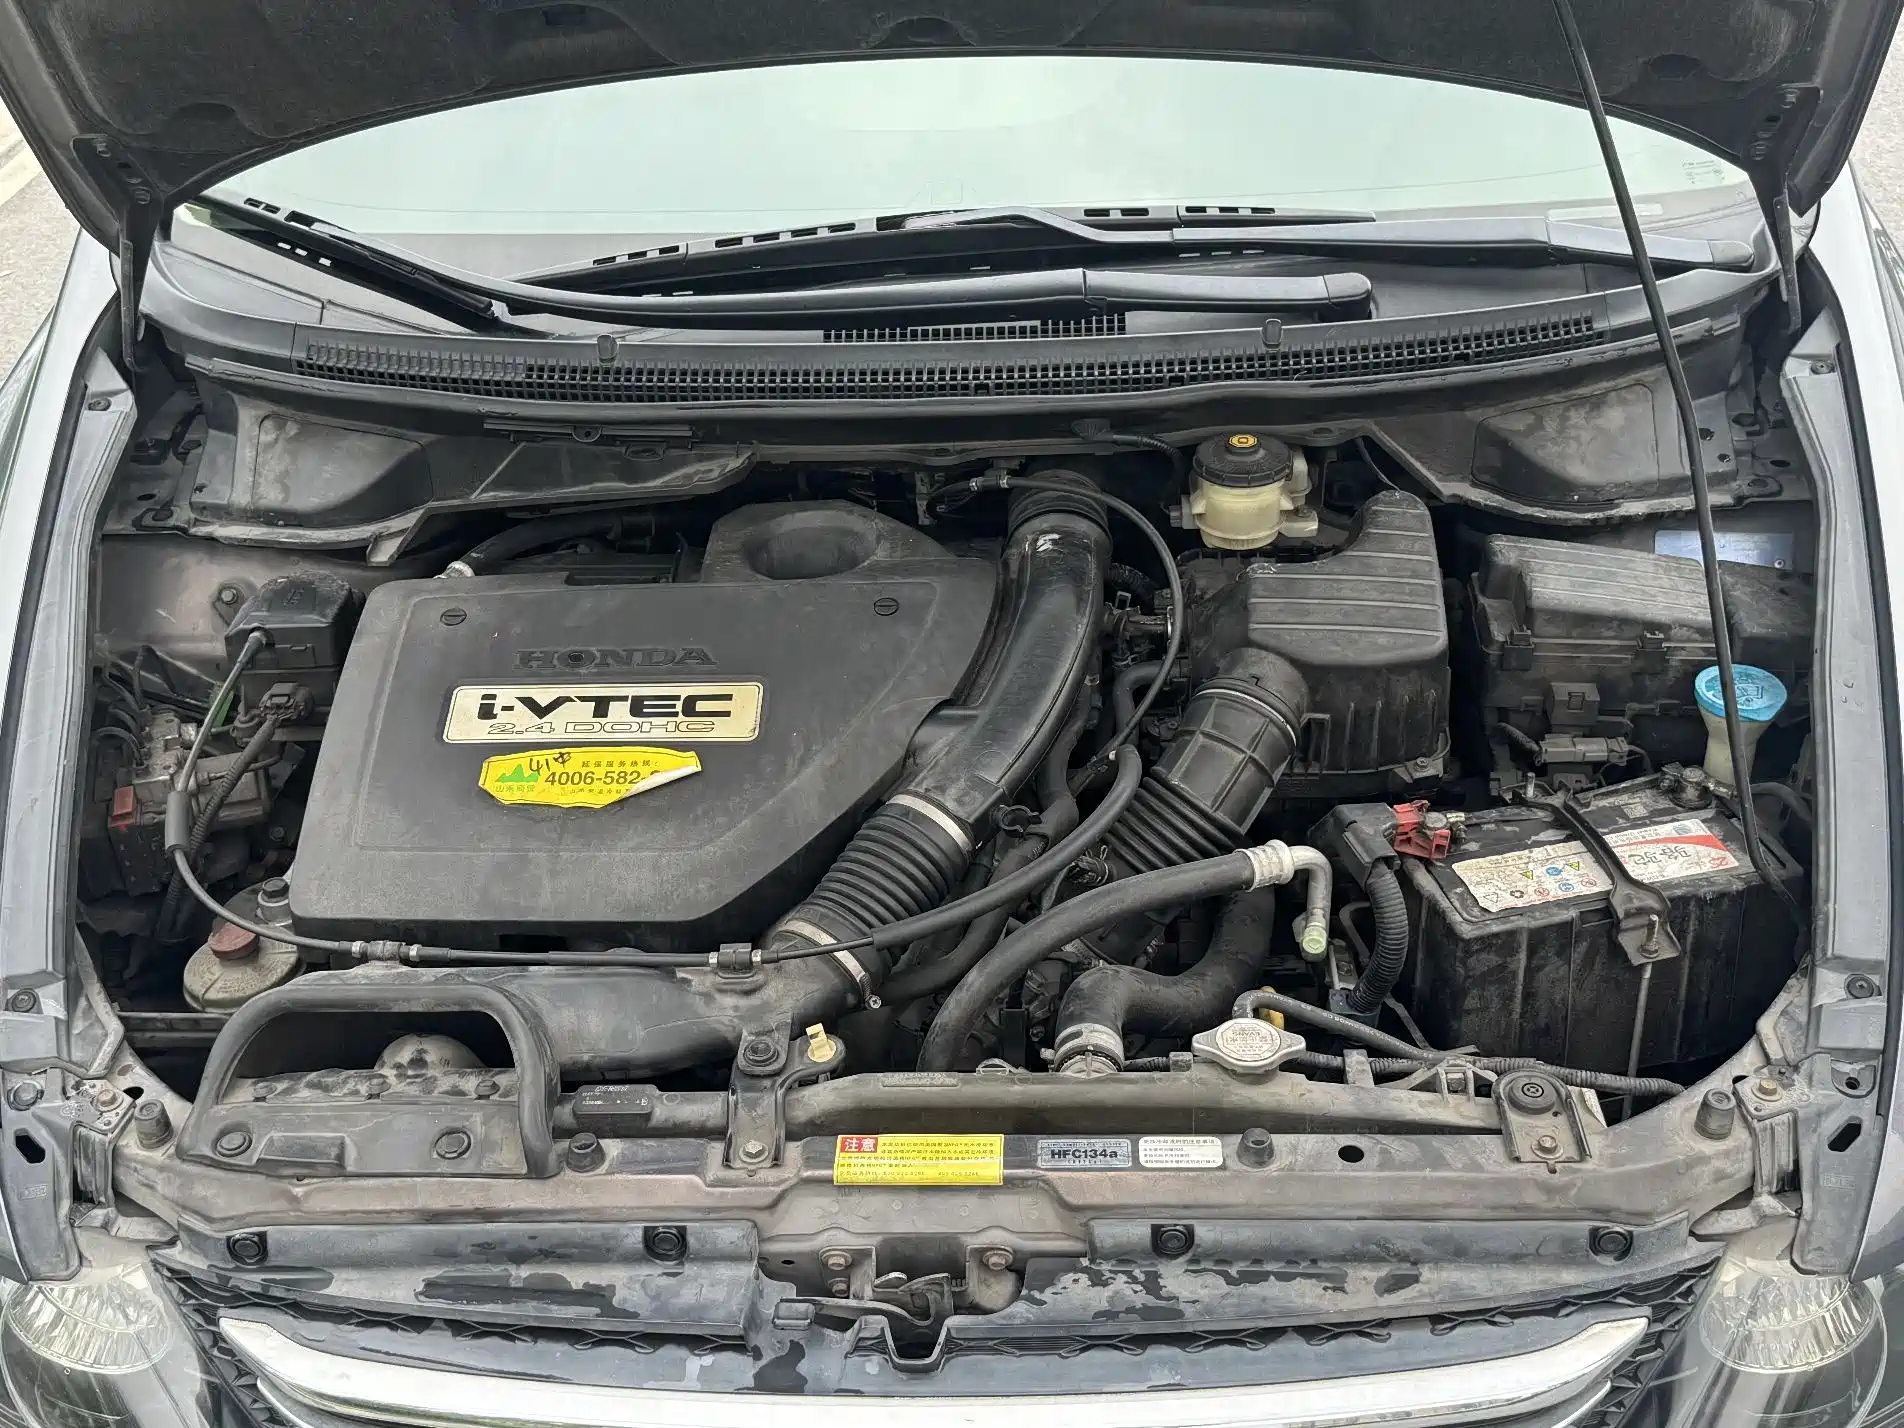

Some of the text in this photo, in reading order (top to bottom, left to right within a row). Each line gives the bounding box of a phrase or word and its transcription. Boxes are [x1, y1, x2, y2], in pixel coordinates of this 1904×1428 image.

[513, 646, 719, 669] HONDA
[478, 693, 734, 721] i-VTEC
[488, 720, 715, 735] 2.4 DOHC
[844, 1139, 876, 1152] 注意
[1051, 1149, 1118, 1159] HFC134a
